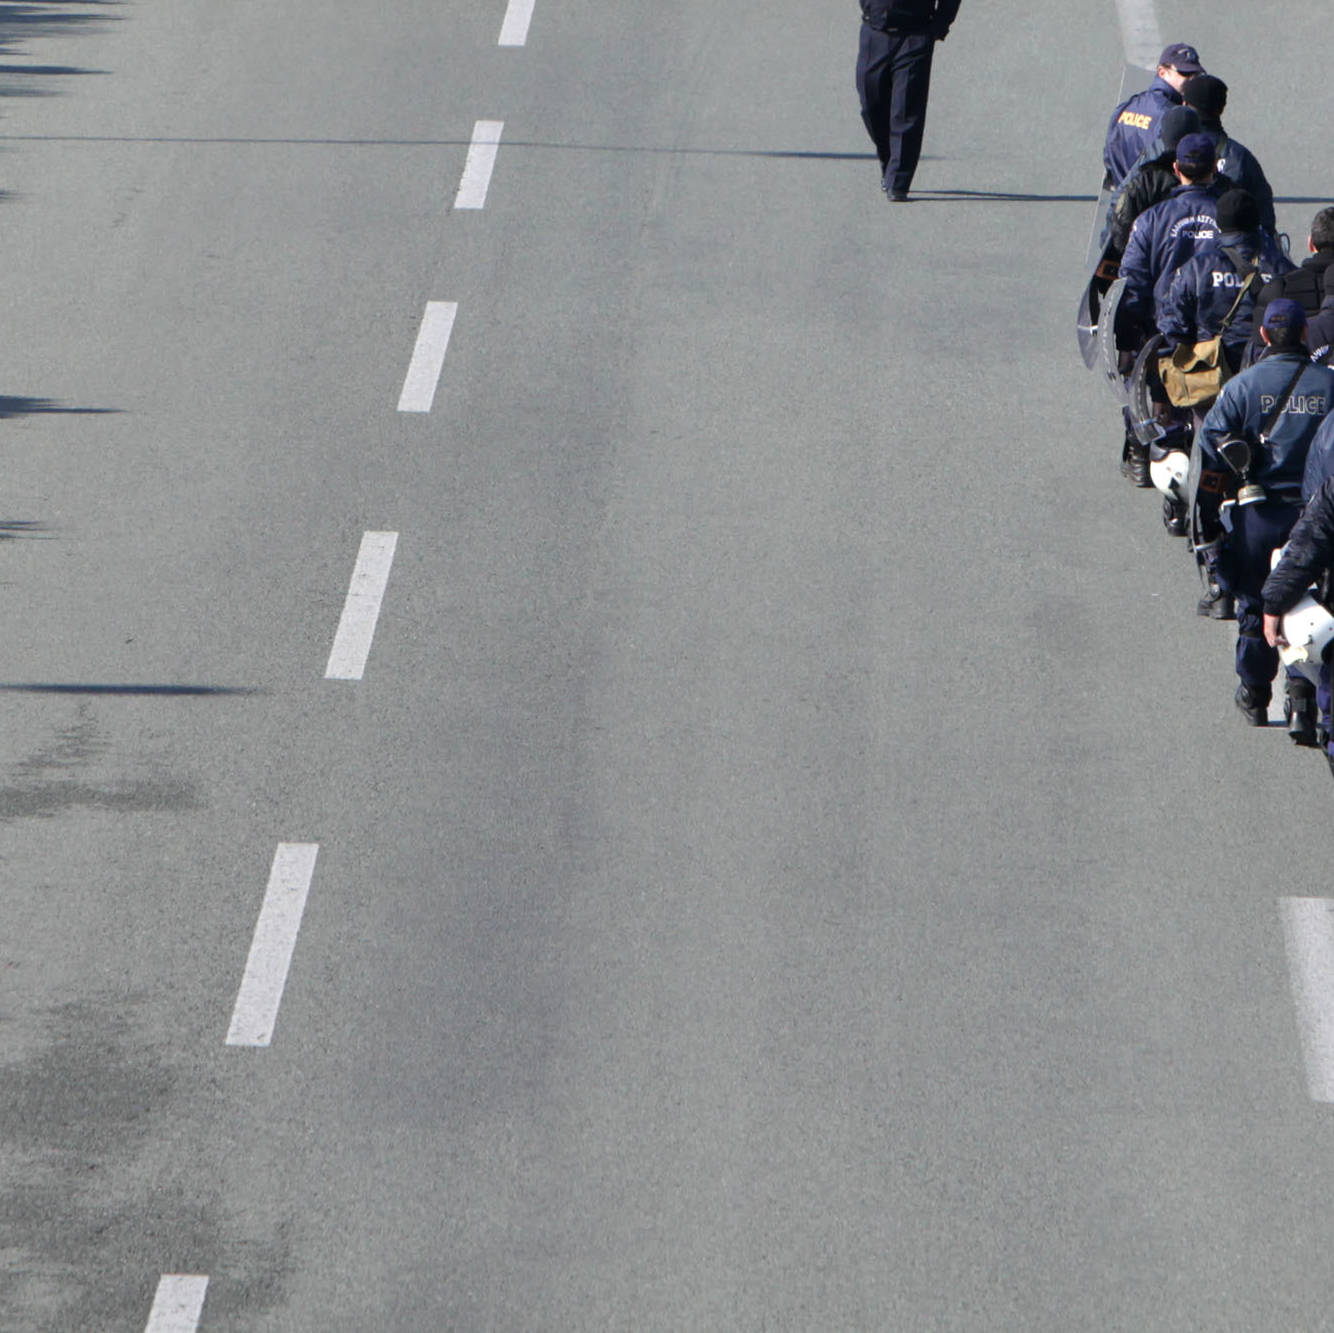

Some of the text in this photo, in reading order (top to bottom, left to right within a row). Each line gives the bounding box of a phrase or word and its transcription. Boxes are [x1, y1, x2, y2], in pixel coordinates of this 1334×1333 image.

[1118, 111, 1152, 130] POLICE
[1182, 230, 1214, 239] POLICE
[1260, 395, 1327, 415] PLICE
